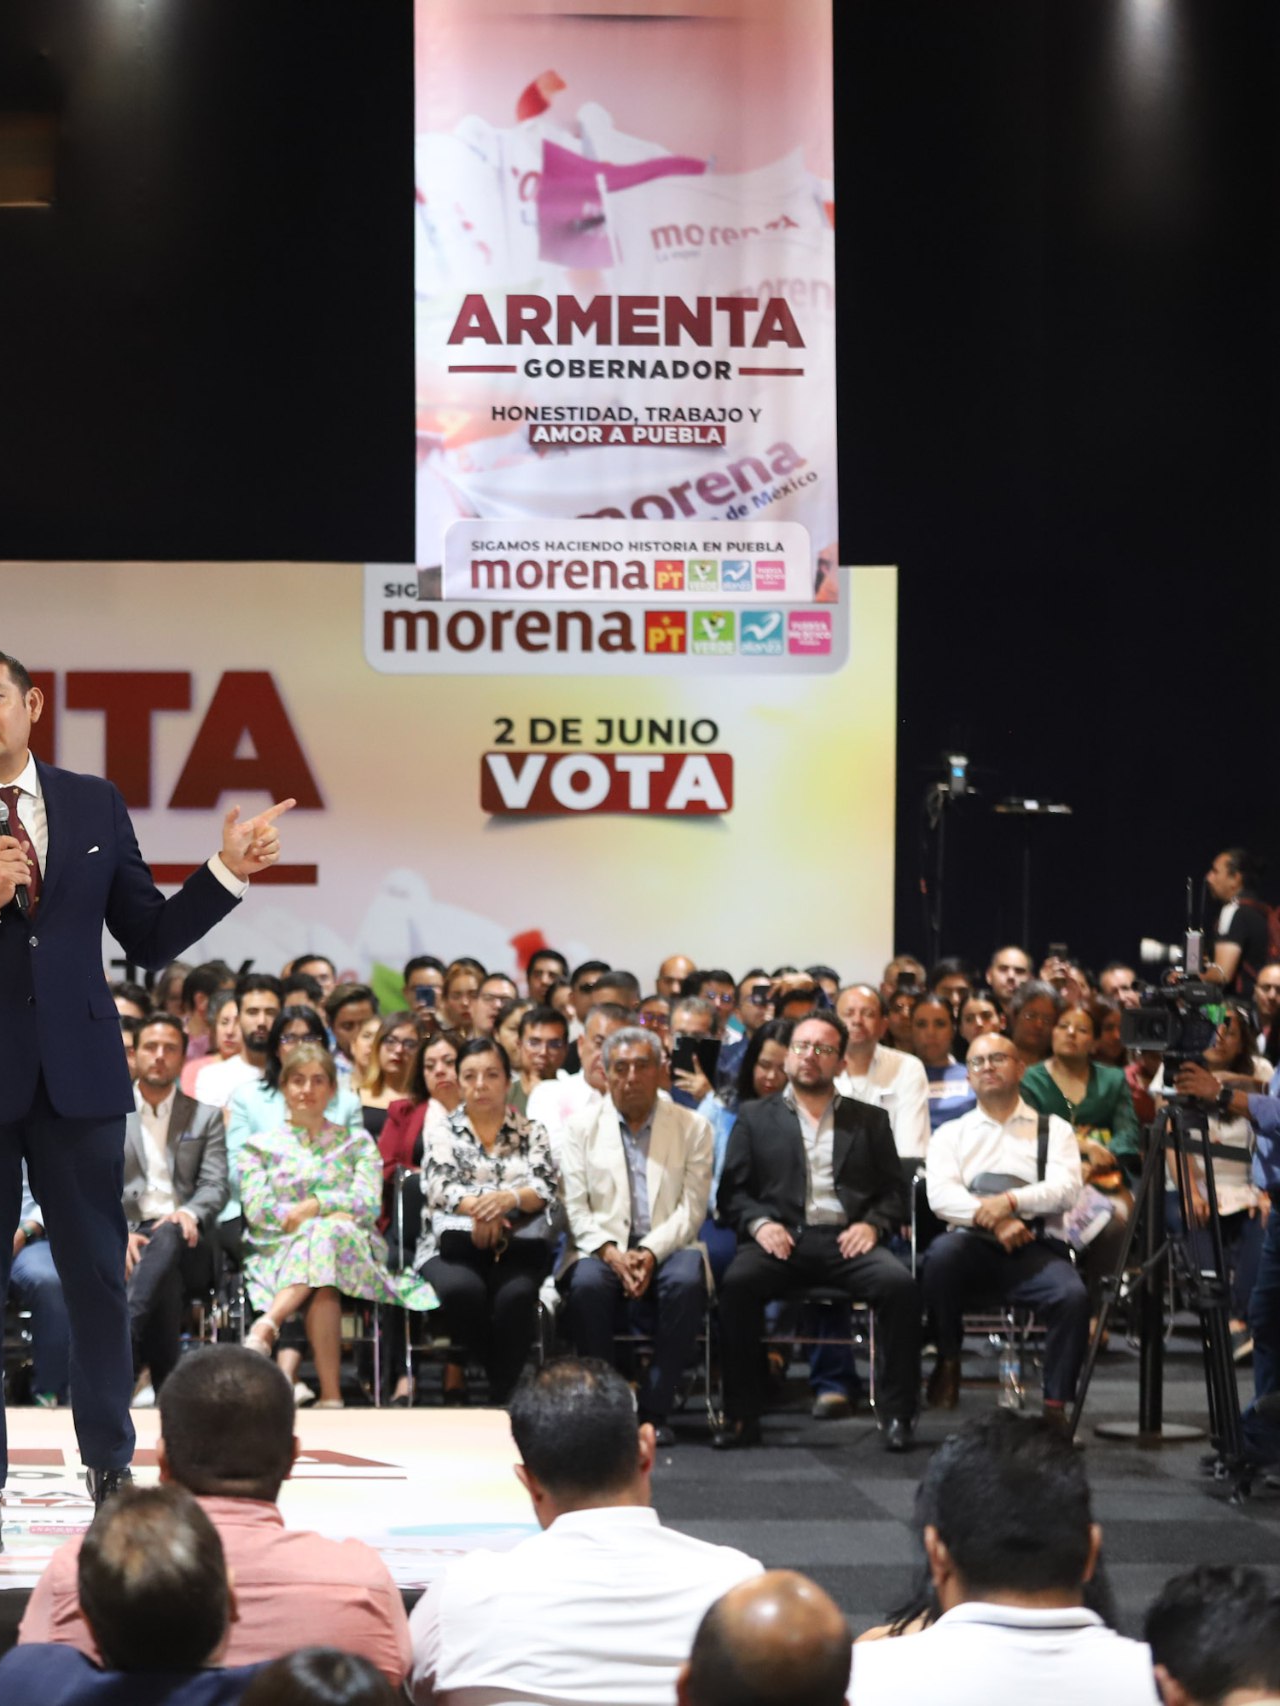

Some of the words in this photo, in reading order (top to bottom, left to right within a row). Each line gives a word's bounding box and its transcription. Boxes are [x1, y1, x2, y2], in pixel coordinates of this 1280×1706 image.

[447, 293, 806, 348] ARMENTA
[523, 359, 732, 380] GOBERNADOR
[491, 405, 639, 424] HONESTIDAD,
[646, 407, 740, 423] TRABAJO
[749, 408, 762, 424] Y
[532, 426, 603, 443] AMOR
[608, 427, 627, 443] A
[631, 426, 723, 444] PUEBLA
[576, 441, 808, 519] orena
[471, 541, 540, 552] SIGAMOS
[545, 541, 624, 553] HACIENDO
[628, 541, 699, 553] HISTORIA
[703, 541, 723, 552] EN
[727, 541, 785, 553] PUEBLA
[470, 559, 649, 591] morena
[656, 571, 683, 589] PT
[382, 608, 636, 653] morena
[647, 626, 686, 652] PT
[493, 717, 516, 745] 2
[529, 718, 583, 745] DE
[596, 718, 719, 746] JUNIO
[485, 753, 728, 811] VOTA
